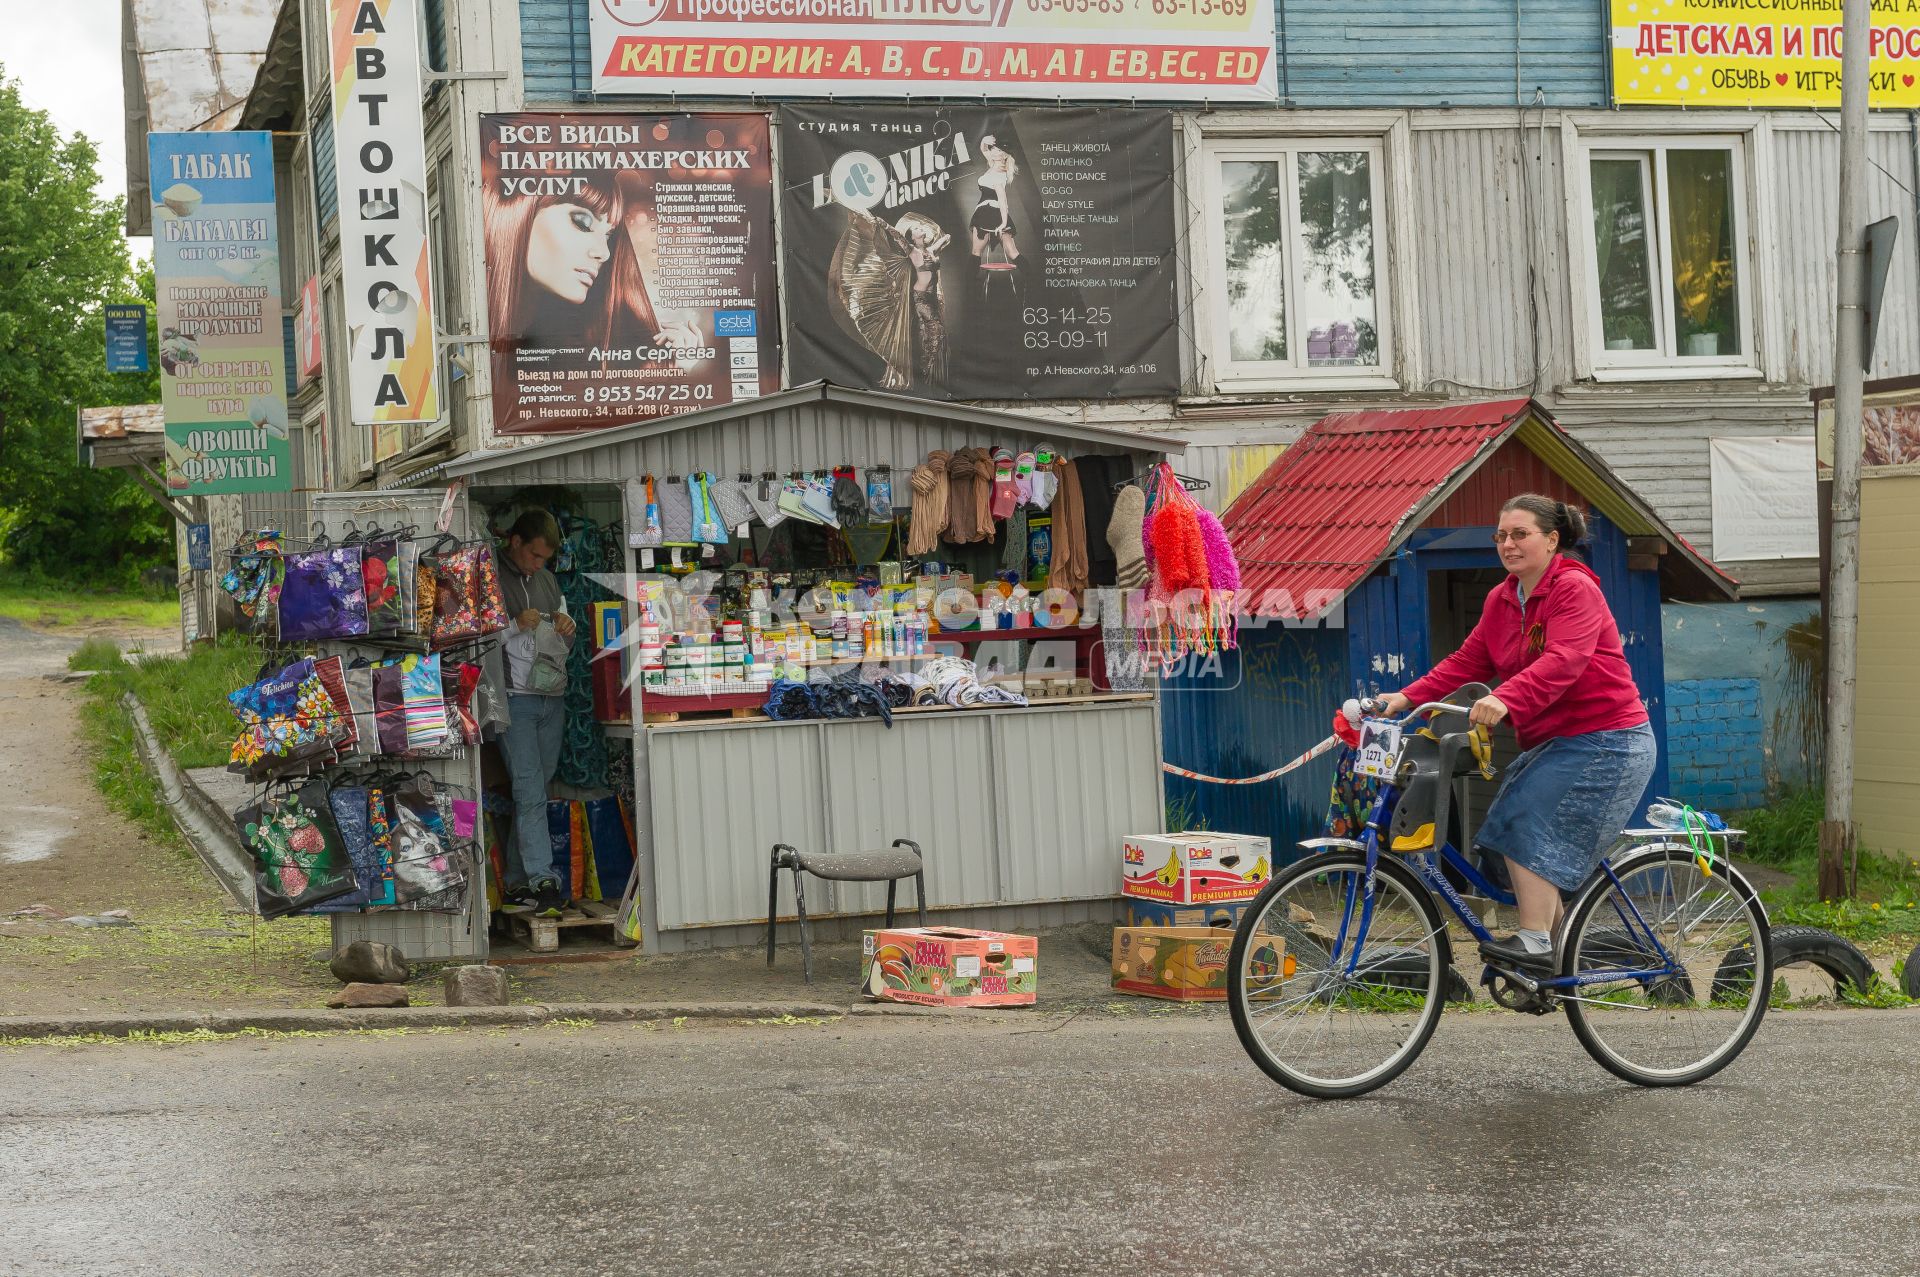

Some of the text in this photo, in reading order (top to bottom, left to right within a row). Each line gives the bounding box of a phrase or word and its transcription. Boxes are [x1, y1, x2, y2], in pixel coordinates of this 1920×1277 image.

[1635, 23, 1772, 57] ДЕТСКАЯ
[1784, 27, 1802, 56] И
[620, 43, 833, 74] КАТЕГОРИИ:
[1217, 51, 1259, 79] ED
[1711, 69, 1896, 91] ОБУВЬ ИГРУКИ
[799, 121, 922, 134] студия танца
[499, 125, 640, 149] ВСЕ ВИДЫ
[1041, 143, 1111, 154] ТАНЕЦ ЖИВОТА
[169, 153, 252, 180] ТАБАК
[500, 150, 751, 170] ПАРИКМАХЕРСКИХ
[1041, 157, 1093, 167] ФЛАМЕНКО
[1041, 172, 1106, 181] EROTIC DANCE
[503, 177, 588, 196] УСЛУГ
[656, 182, 735, 193] Стрижки женские,
[1041, 186, 1073, 195] GO-GO
[353, 1, 408, 406] АВТОШКОЛА
[655, 193, 736, 204] мужские, детские;
[1042, 200, 1094, 209] LADY STYLE
[657, 203, 746, 214] Окрашивание волос;
[657, 214, 741, 224] Укладки, прически;
[1043, 214, 1119, 224] КЛУБНЫЕ ТАНЦЫ
[164, 219, 268, 243] БАКАЛЕЯ
[657, 225, 715, 235] Био завивки,
[1044, 228, 1080, 237] ЛАТИНА
[657, 235, 673, 245] био
[226, 245, 238, 260] 5
[658, 245, 747, 256] Макияж свадебный,
[1044, 243, 1082, 252] ФИТНЕС
[705, 255, 744, 266] дневной;
[1046, 255, 1160, 267] ХОРЕОГРАФИЯ ДЛЯ ДЕТЕЙ
[659, 267, 736, 277] Полировка волос;
[1046, 278, 1137, 289] ПОСТАНОВКА ТАНЦА
[169, 286, 268, 303] Новгородские
[659, 287, 741, 299] коррекция бровей;
[177, 301, 262, 319] МОЛОЧНЫЕ
[661, 298, 720, 310] Окрашивание
[719, 314, 751, 329] estel
[1023, 307, 1112, 325] 63-14-25
[179, 318, 263, 337] ПРОДУКТЫ
[1024, 331, 1108, 349] 63-09-11
[588, 346, 632, 361] Анна
[635, 345, 716, 363] Сергеева
[199, 361, 272, 378] ФЕРМЕРА
[517, 368, 687, 382] Выезд на дом по договоренности.
[1027, 367, 1042, 377] пр.
[177, 380, 272, 398] парное мясо
[518, 384, 562, 393] Телефон
[584, 384, 713, 402] 8 953 547 25 01
[518, 393, 577, 404] для записи:
[207, 398, 244, 415] кура
[519, 409, 537, 420] пр.
[540, 407, 593, 419] Невского,
[187, 428, 268, 453] ОВОЩИ
[181, 455, 277, 481] ФРУКТЫ
[1125, 844, 1145, 862] Dole
[1189, 847, 1213, 860] Dole
[1192, 890, 1231, 901] PREMIUM
